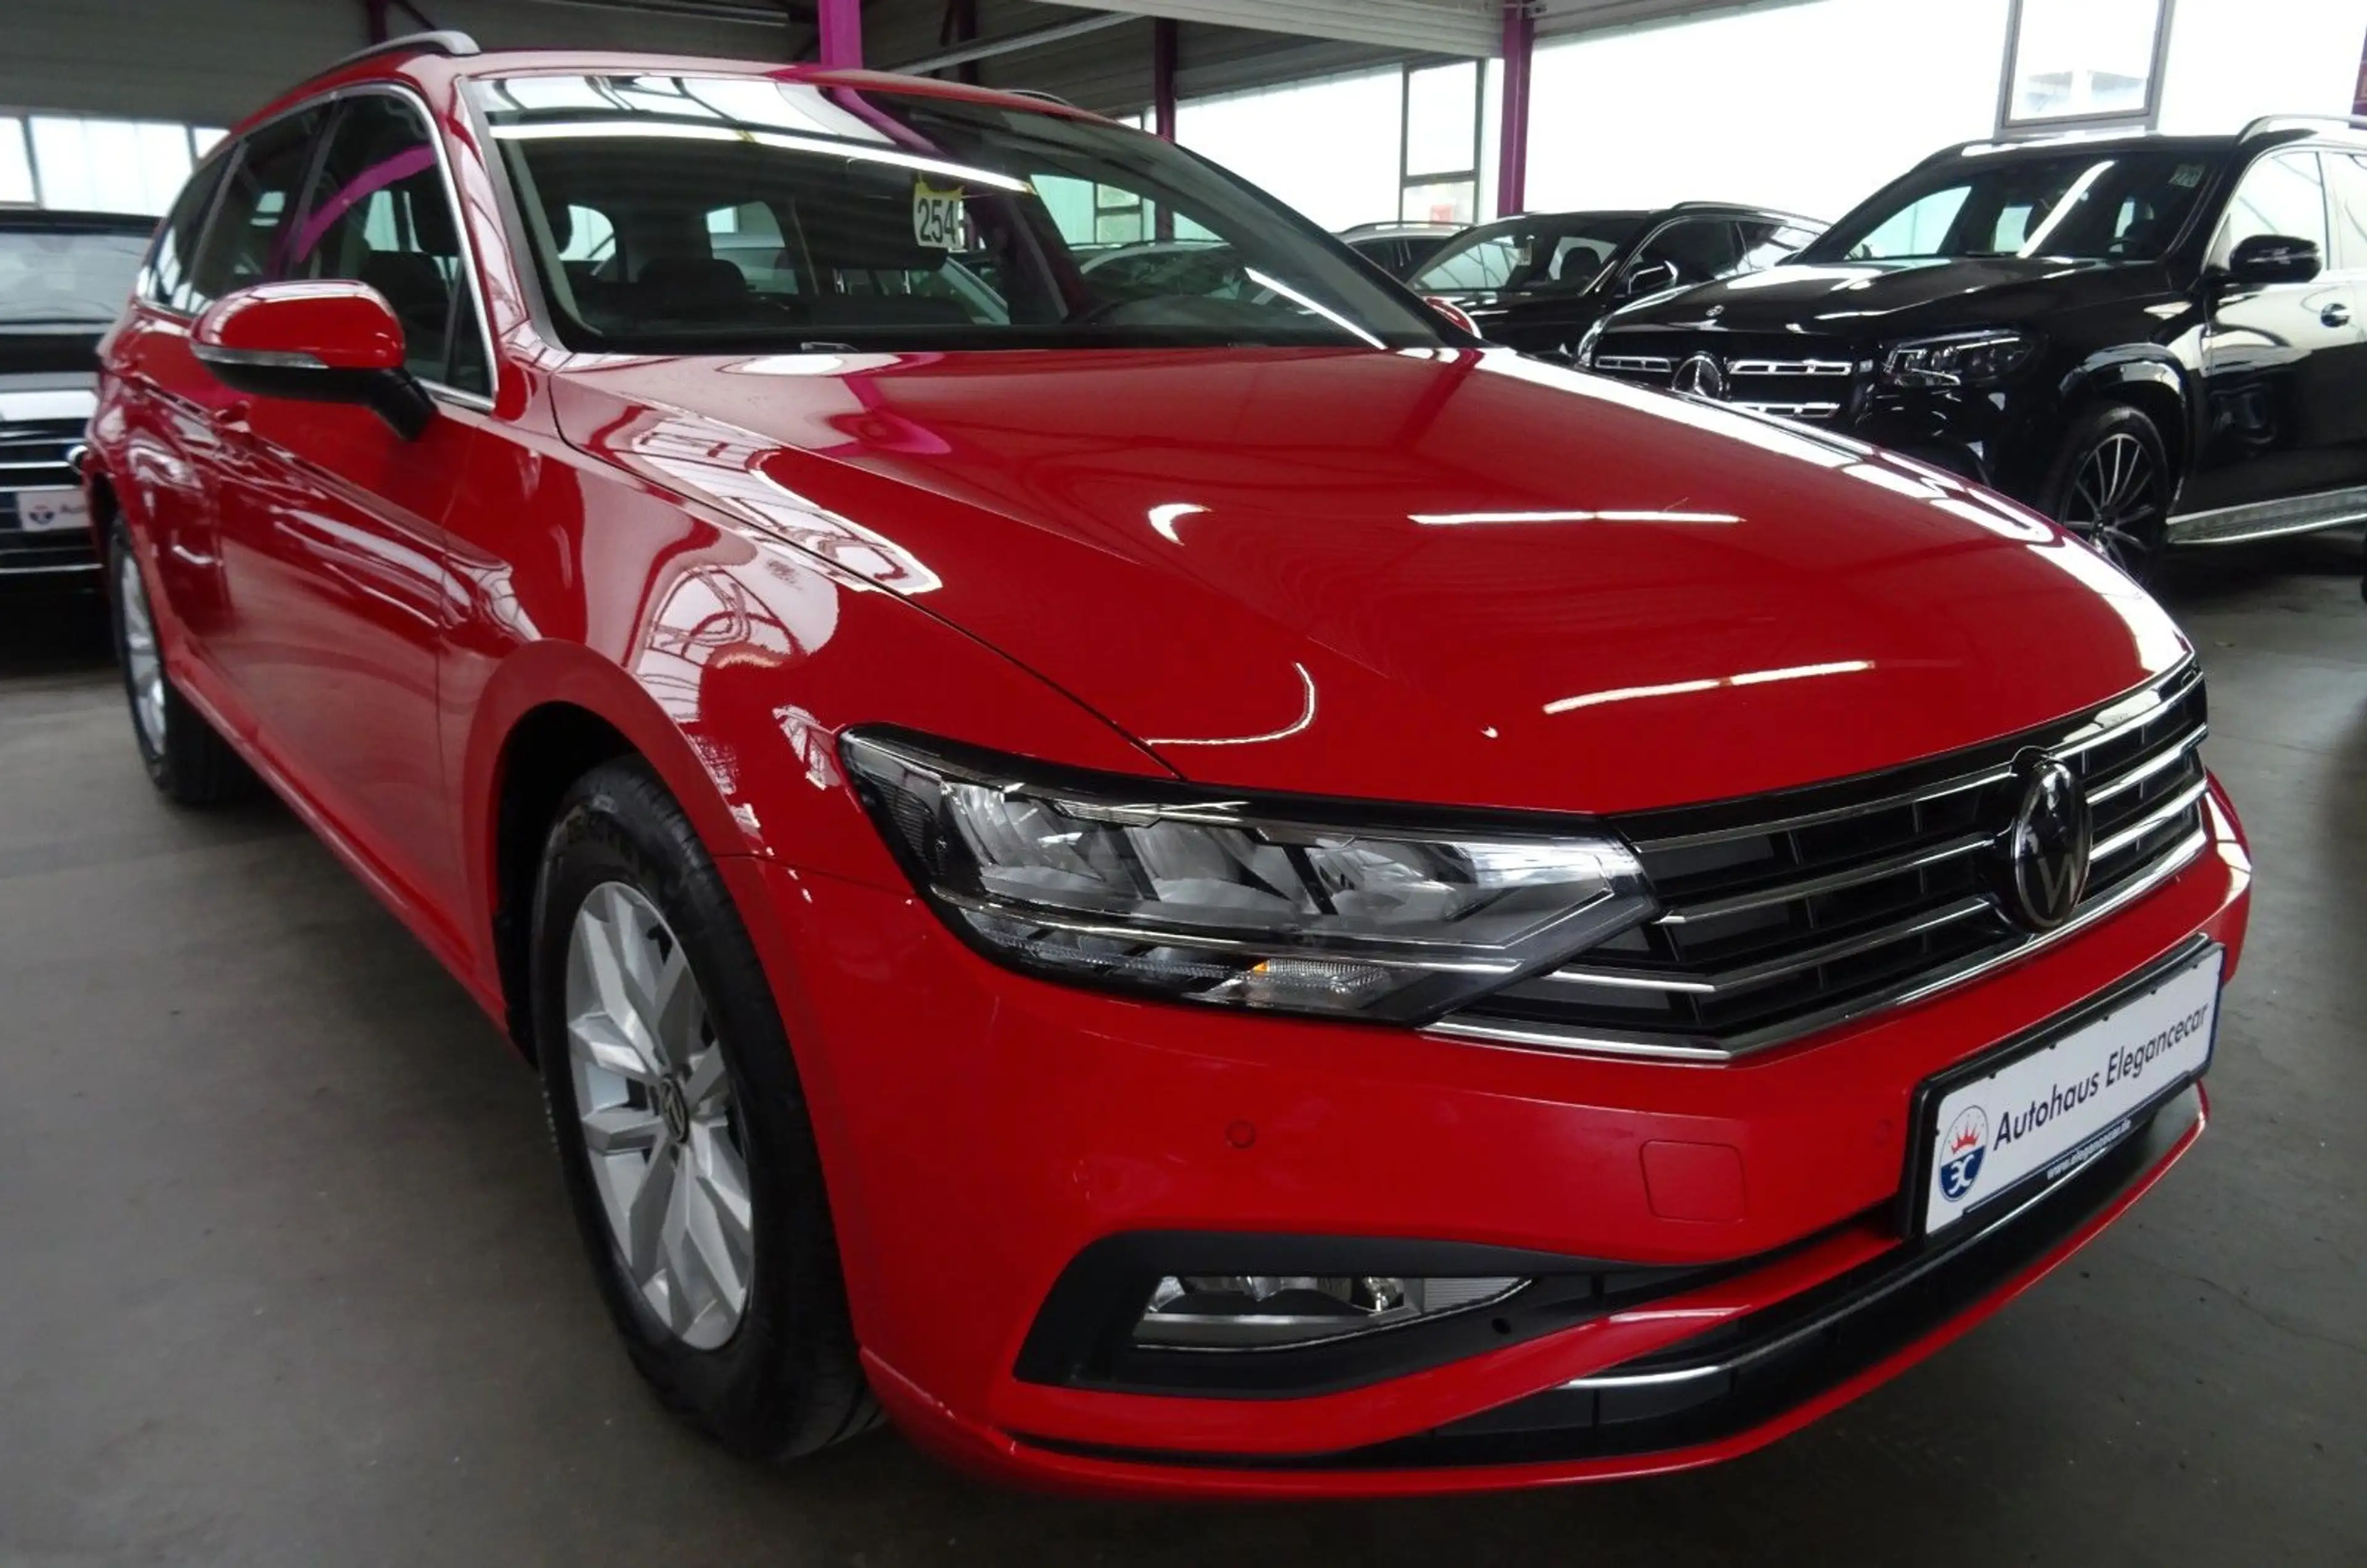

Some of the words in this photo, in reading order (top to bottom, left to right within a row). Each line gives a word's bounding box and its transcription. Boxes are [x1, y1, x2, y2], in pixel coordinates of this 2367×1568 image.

[917, 197, 956, 244] 254
[1993, 1072, 2099, 1151] Autohaus
[2106, 1003, 2208, 1088] Elegancecar
